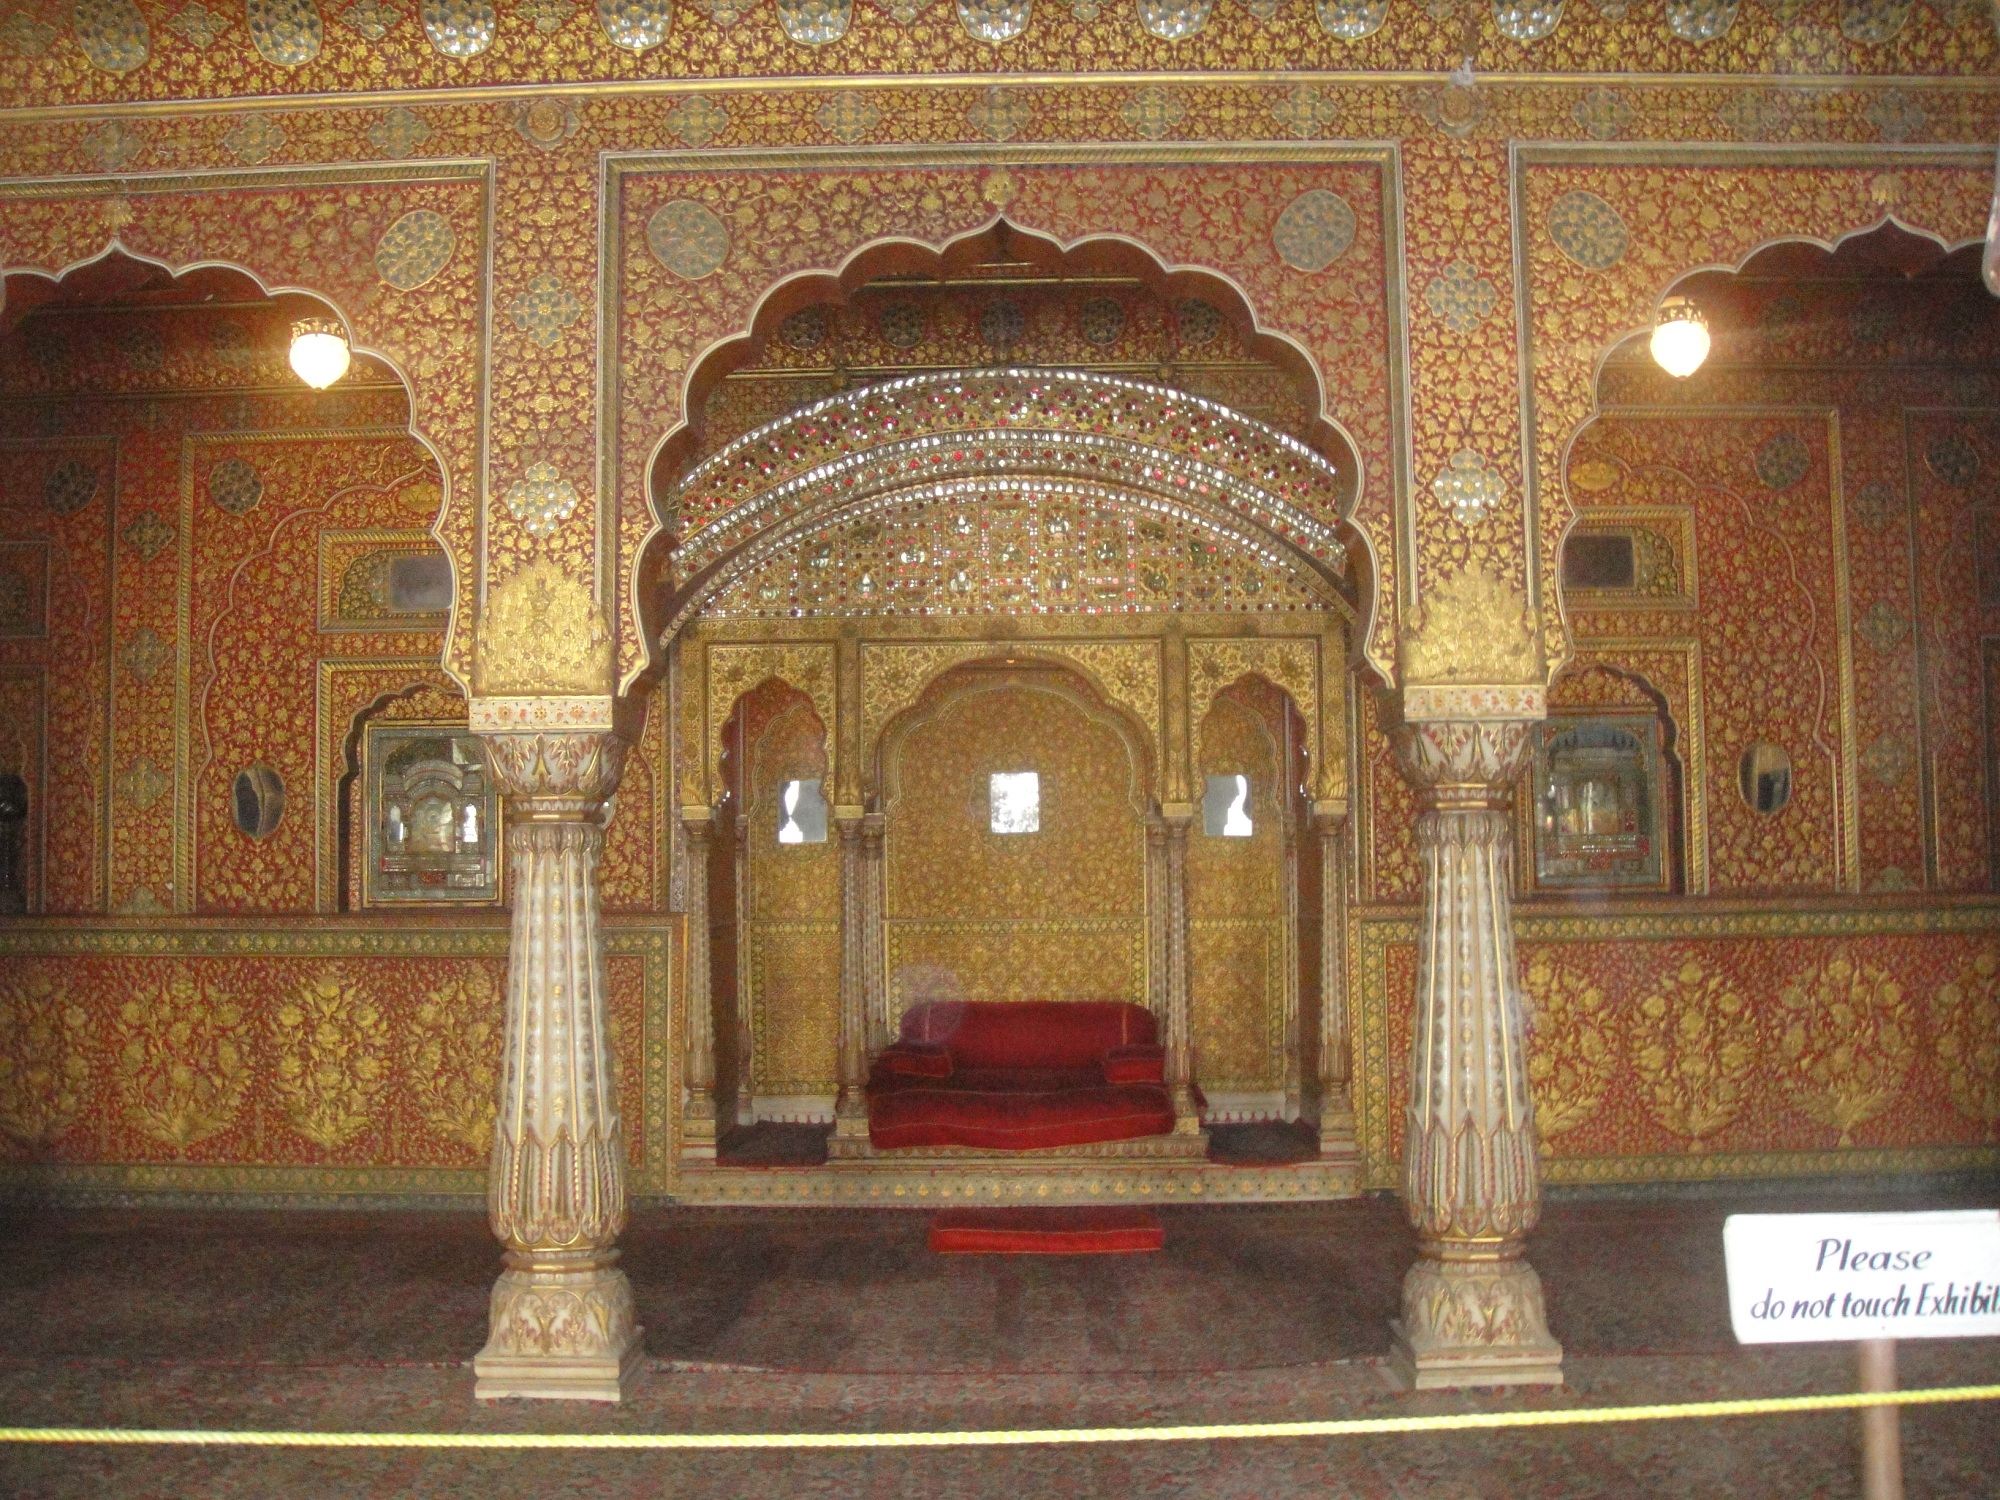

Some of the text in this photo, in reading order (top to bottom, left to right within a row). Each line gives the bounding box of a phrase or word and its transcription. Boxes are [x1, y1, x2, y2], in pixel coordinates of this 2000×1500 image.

[1816, 1238, 1932, 1272] Please
[1750, 1281, 2000, 1319] do not touch Exhibit
